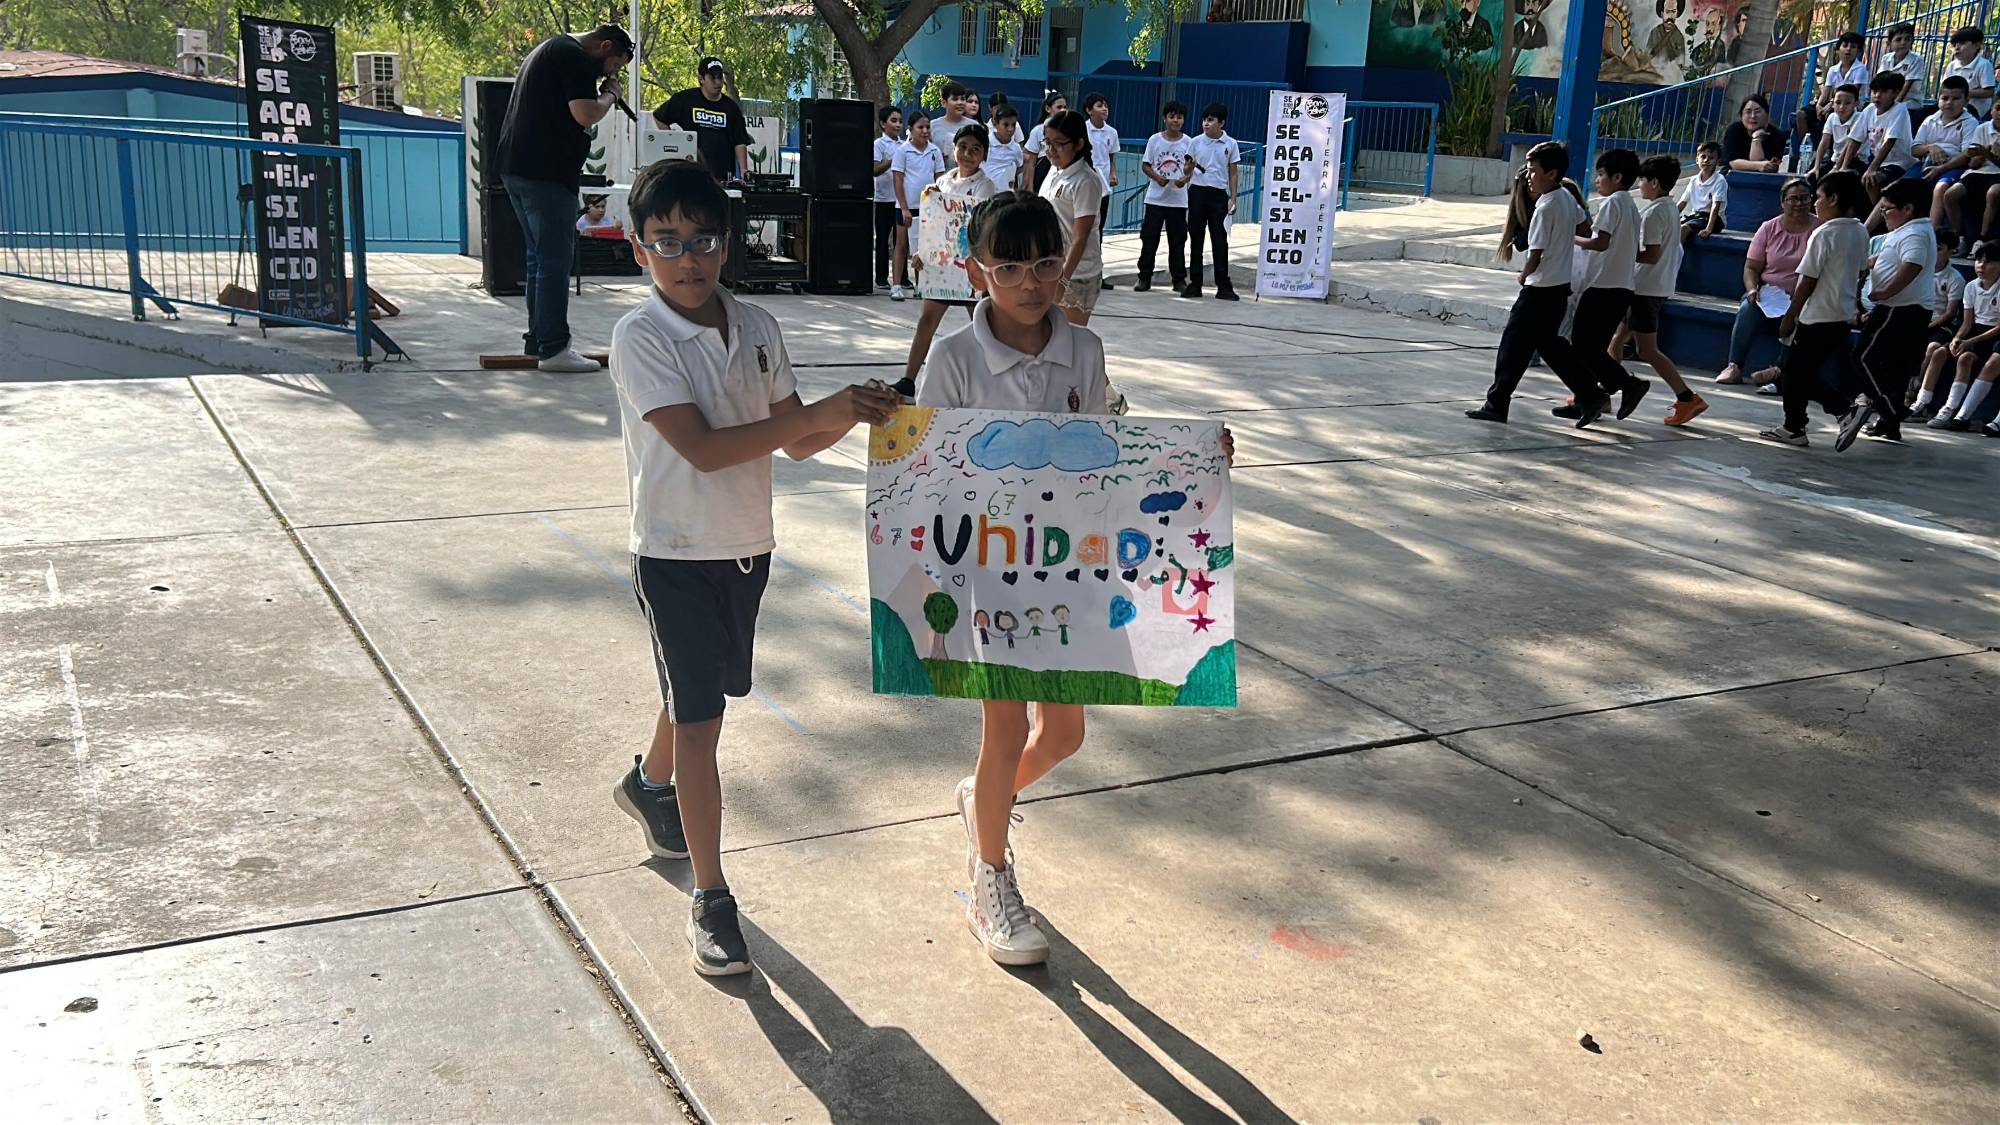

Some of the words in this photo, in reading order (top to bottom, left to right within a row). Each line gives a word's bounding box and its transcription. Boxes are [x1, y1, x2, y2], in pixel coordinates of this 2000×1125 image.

[257, 25, 270, 36] SE
[256, 68, 290, 93] SE
[260, 100, 311, 126] ACA
[696, 111, 723, 124] suma
[743, 116, 765, 128] RIA
[1275, 125, 1301, 140] SE
[1274, 145, 1313, 162] ACA
[1321, 127, 1332, 190] TIERRA
[1273, 162, 1300, 182] BÓ
[1271, 187, 1312, 203] -EL-
[265, 195, 299, 218] SI
[1269, 208, 1293, 223] SI
[268, 226, 318, 249] LEN
[1268, 228, 1307, 244] LEN
[1266, 249, 1303, 265] CIO
[270, 256, 317, 280] CIO
